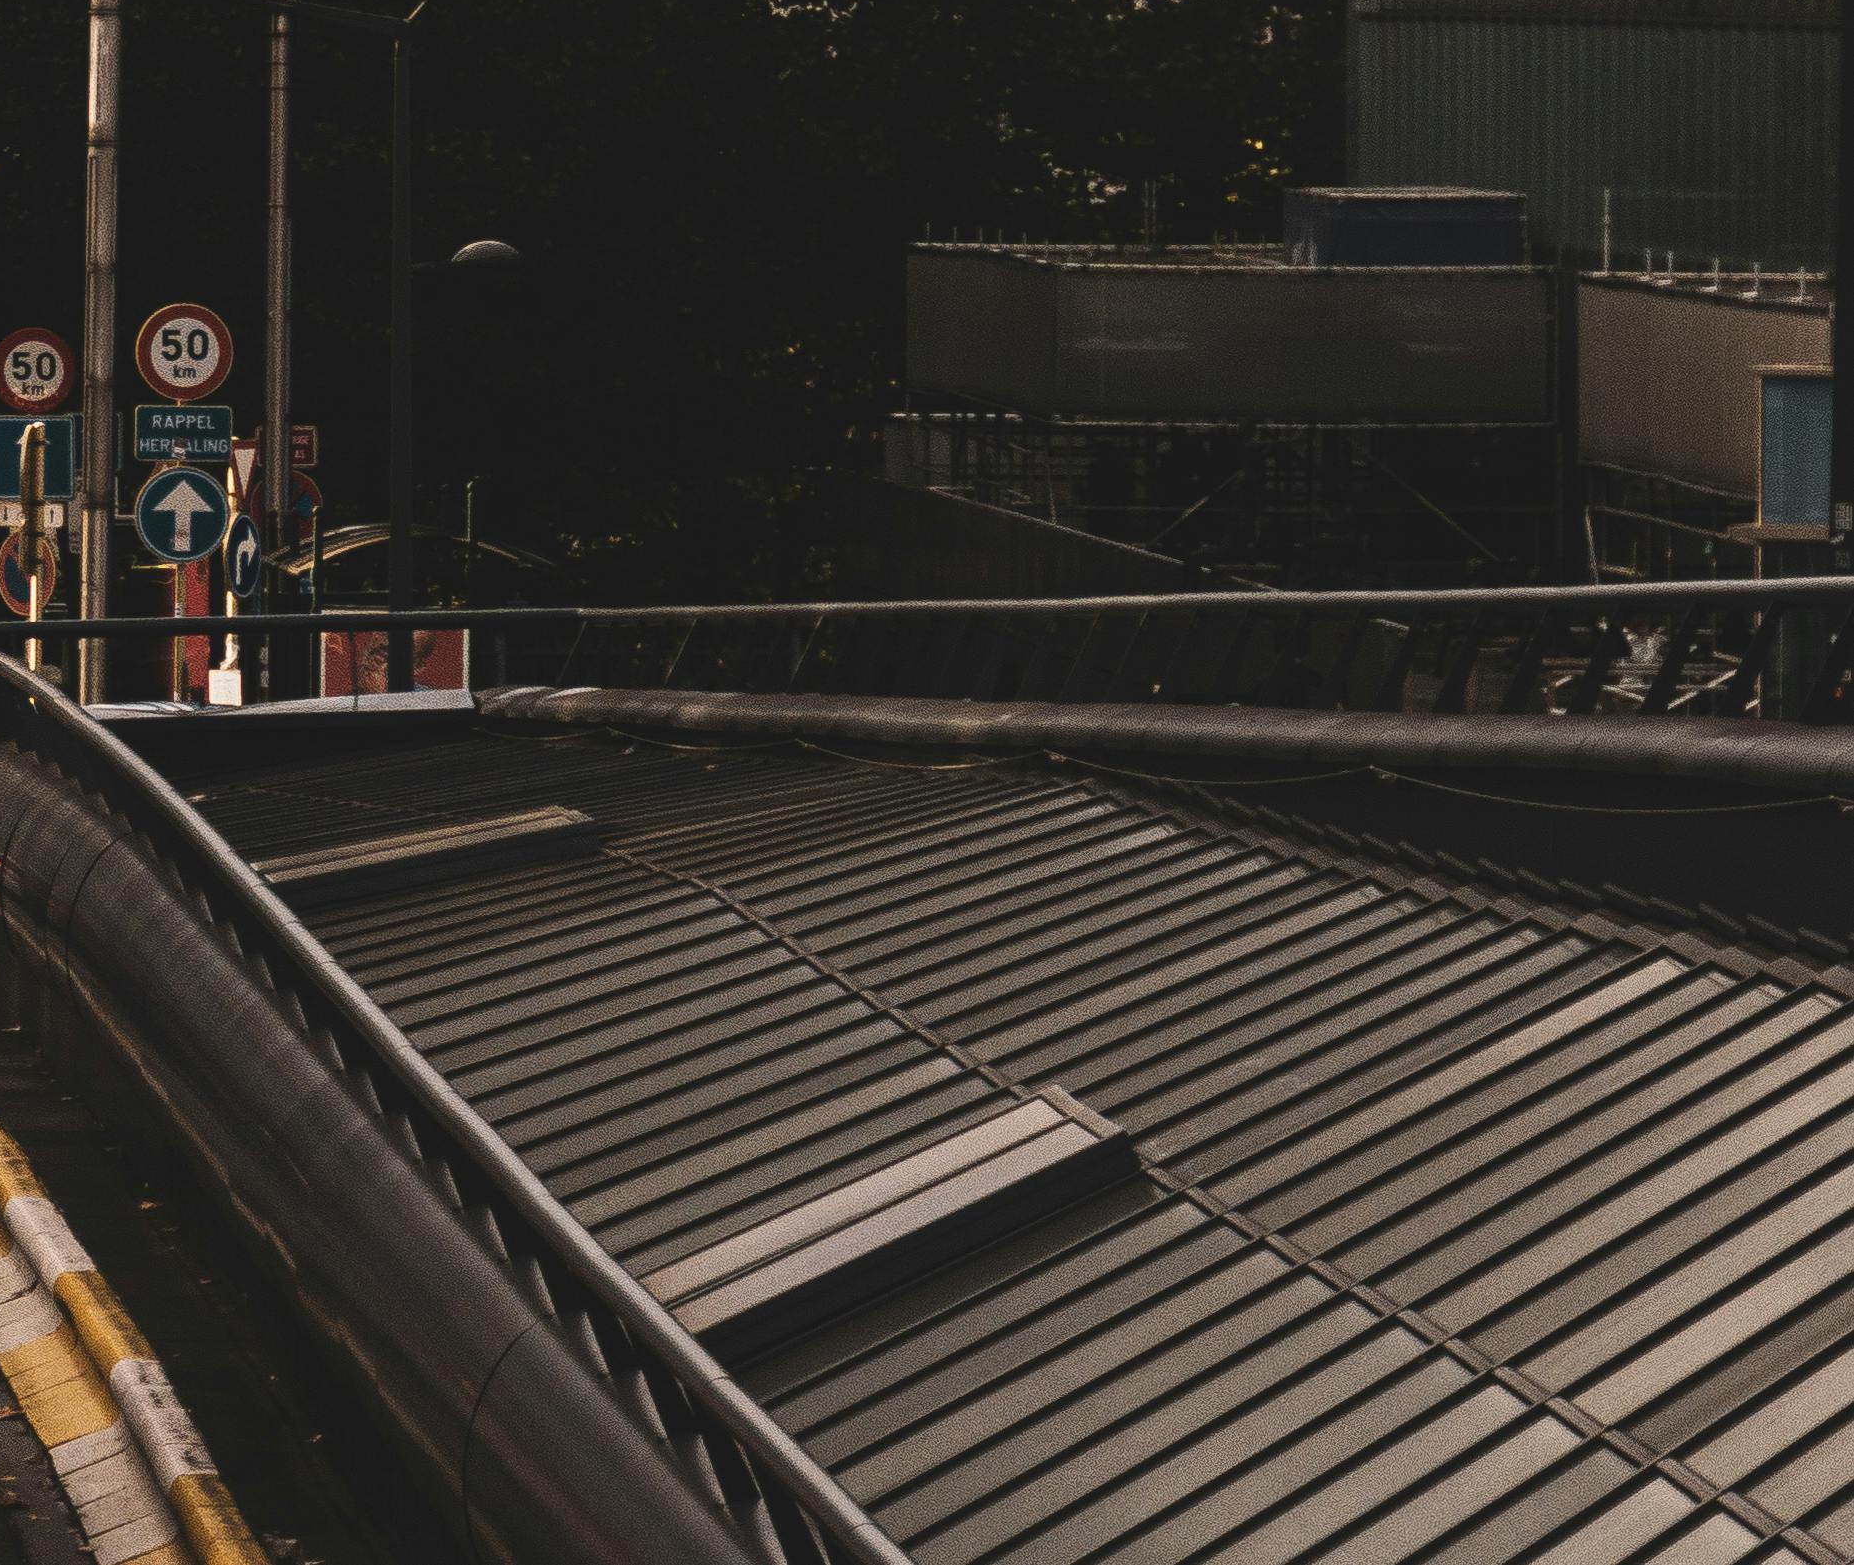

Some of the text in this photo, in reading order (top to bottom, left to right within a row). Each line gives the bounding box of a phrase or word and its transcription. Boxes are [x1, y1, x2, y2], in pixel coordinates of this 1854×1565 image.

[160, 328, 209, 362] 50
[12, 351, 57, 382] 50
[172, 364, 197, 379] km
[21, 382, 45, 396] km
[152, 414, 216, 430] RAPPEL
